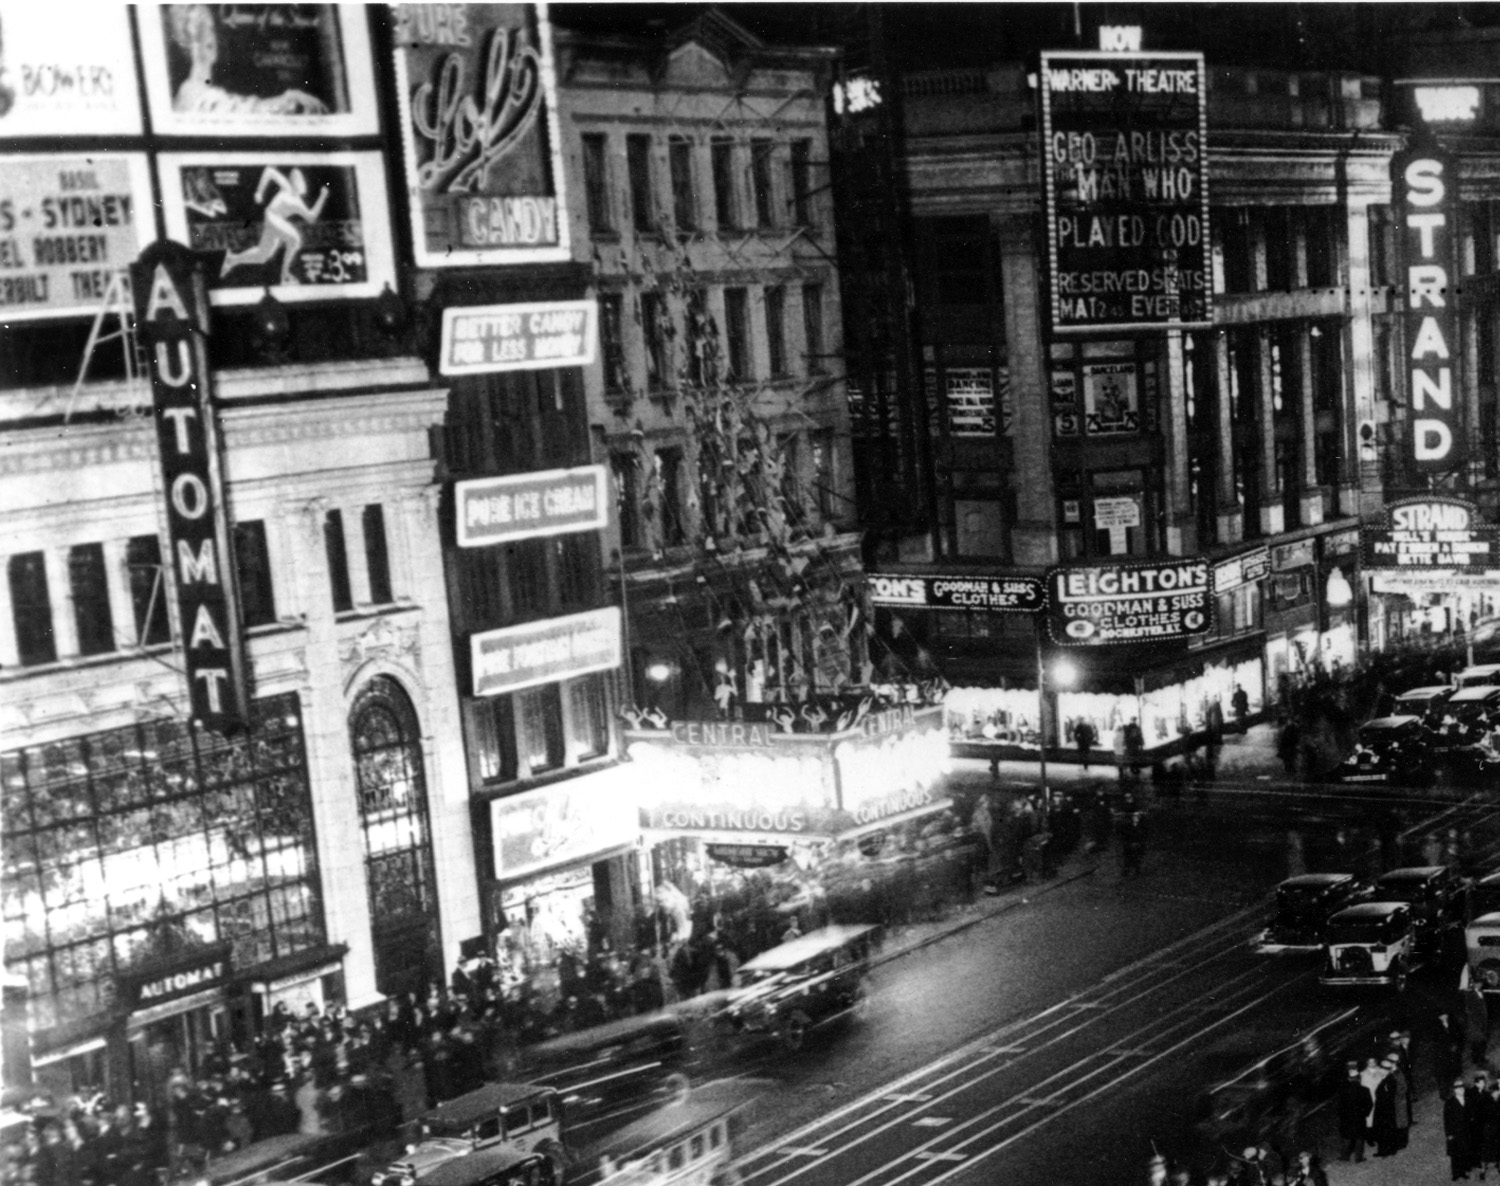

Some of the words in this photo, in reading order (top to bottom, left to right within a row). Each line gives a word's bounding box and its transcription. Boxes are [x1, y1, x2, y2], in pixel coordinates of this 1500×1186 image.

[1125, 69, 1197, 93] THEATRE
[1114, 131, 1198, 164] ARLISS
[1142, 167, 1192, 200] WHO
[41, 195, 132, 229] SYDNEY
[469, 197, 557, 244] CANDY
[1058, 215, 1145, 248] PLAYED
[1058, 269, 1150, 294] RESERVED
[1404, 157, 1455, 465] STRAND
[145, 262, 227, 715] AUTOMAT
[1392, 503, 1470, 530] STRAND
[1056, 563, 1209, 603] LEIGHTON'S
[1063, 599, 1154, 618] GOODMAN
[1171, 593, 1205, 611] SUSS
[1099, 611, 1181, 629] CLOTHES
[671, 720, 776, 748] CENTRAL
[663, 811, 802, 833] CONTINUOUS
[140, 961, 224, 999] AUTOMAT
